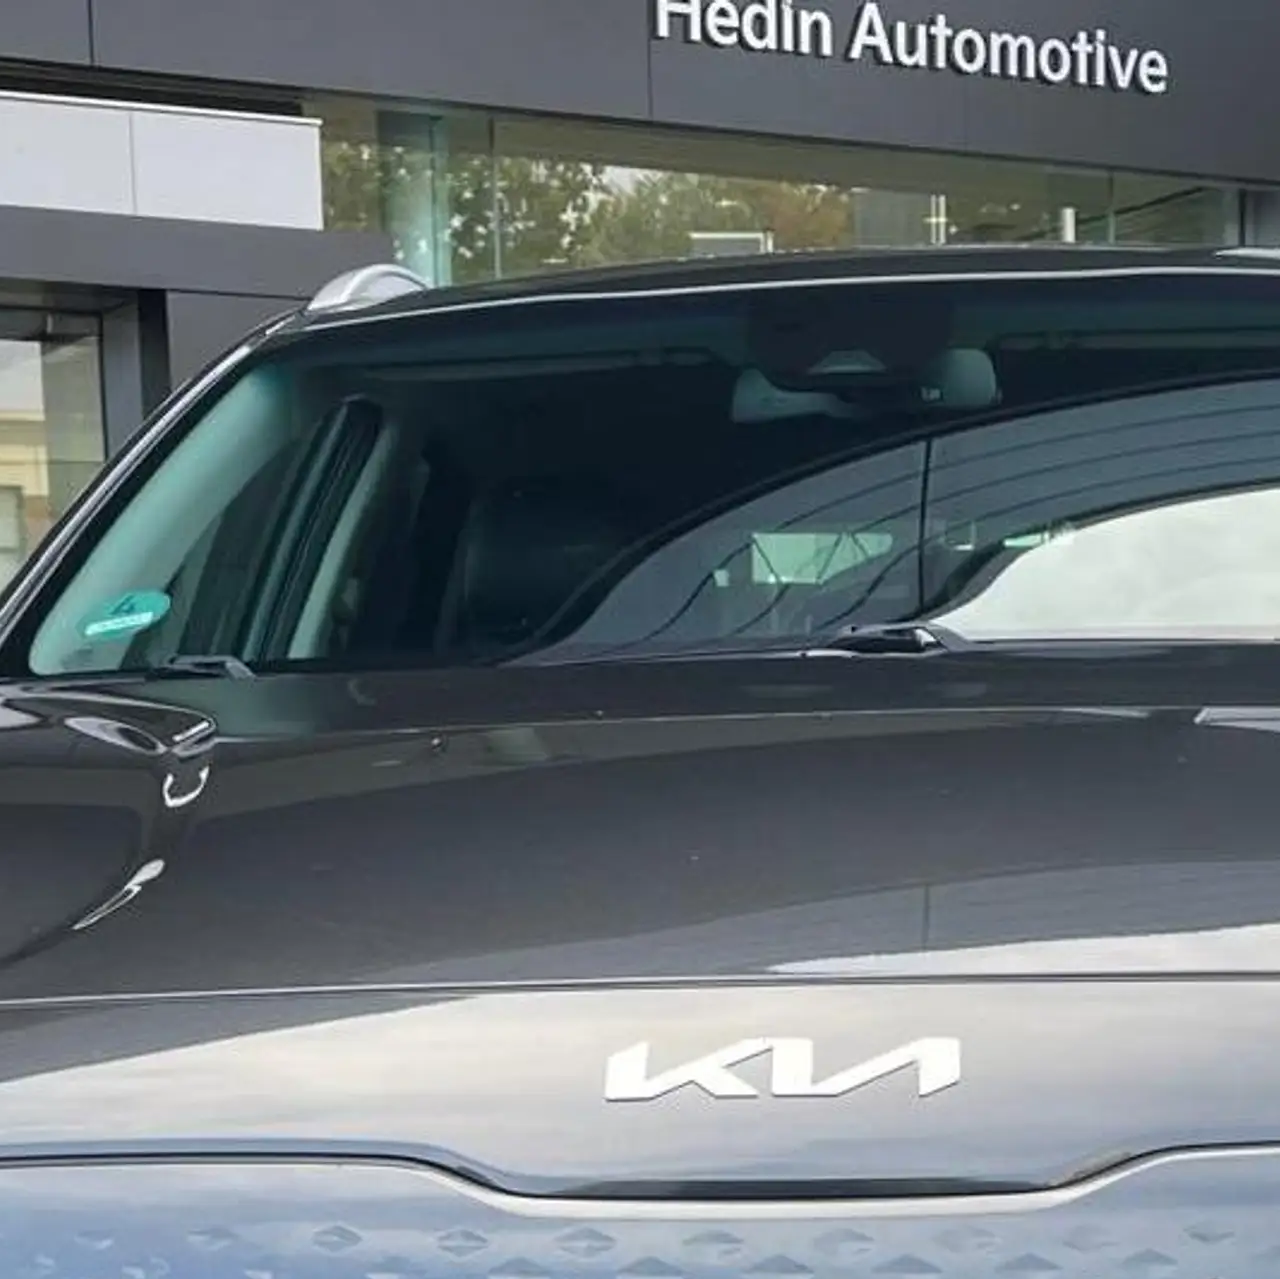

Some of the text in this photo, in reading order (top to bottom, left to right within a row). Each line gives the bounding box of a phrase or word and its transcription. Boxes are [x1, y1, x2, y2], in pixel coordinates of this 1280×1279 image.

[656, 0, 1168, 94] Hedin Automotive
[605, 1036, 961, 1102] KIA
